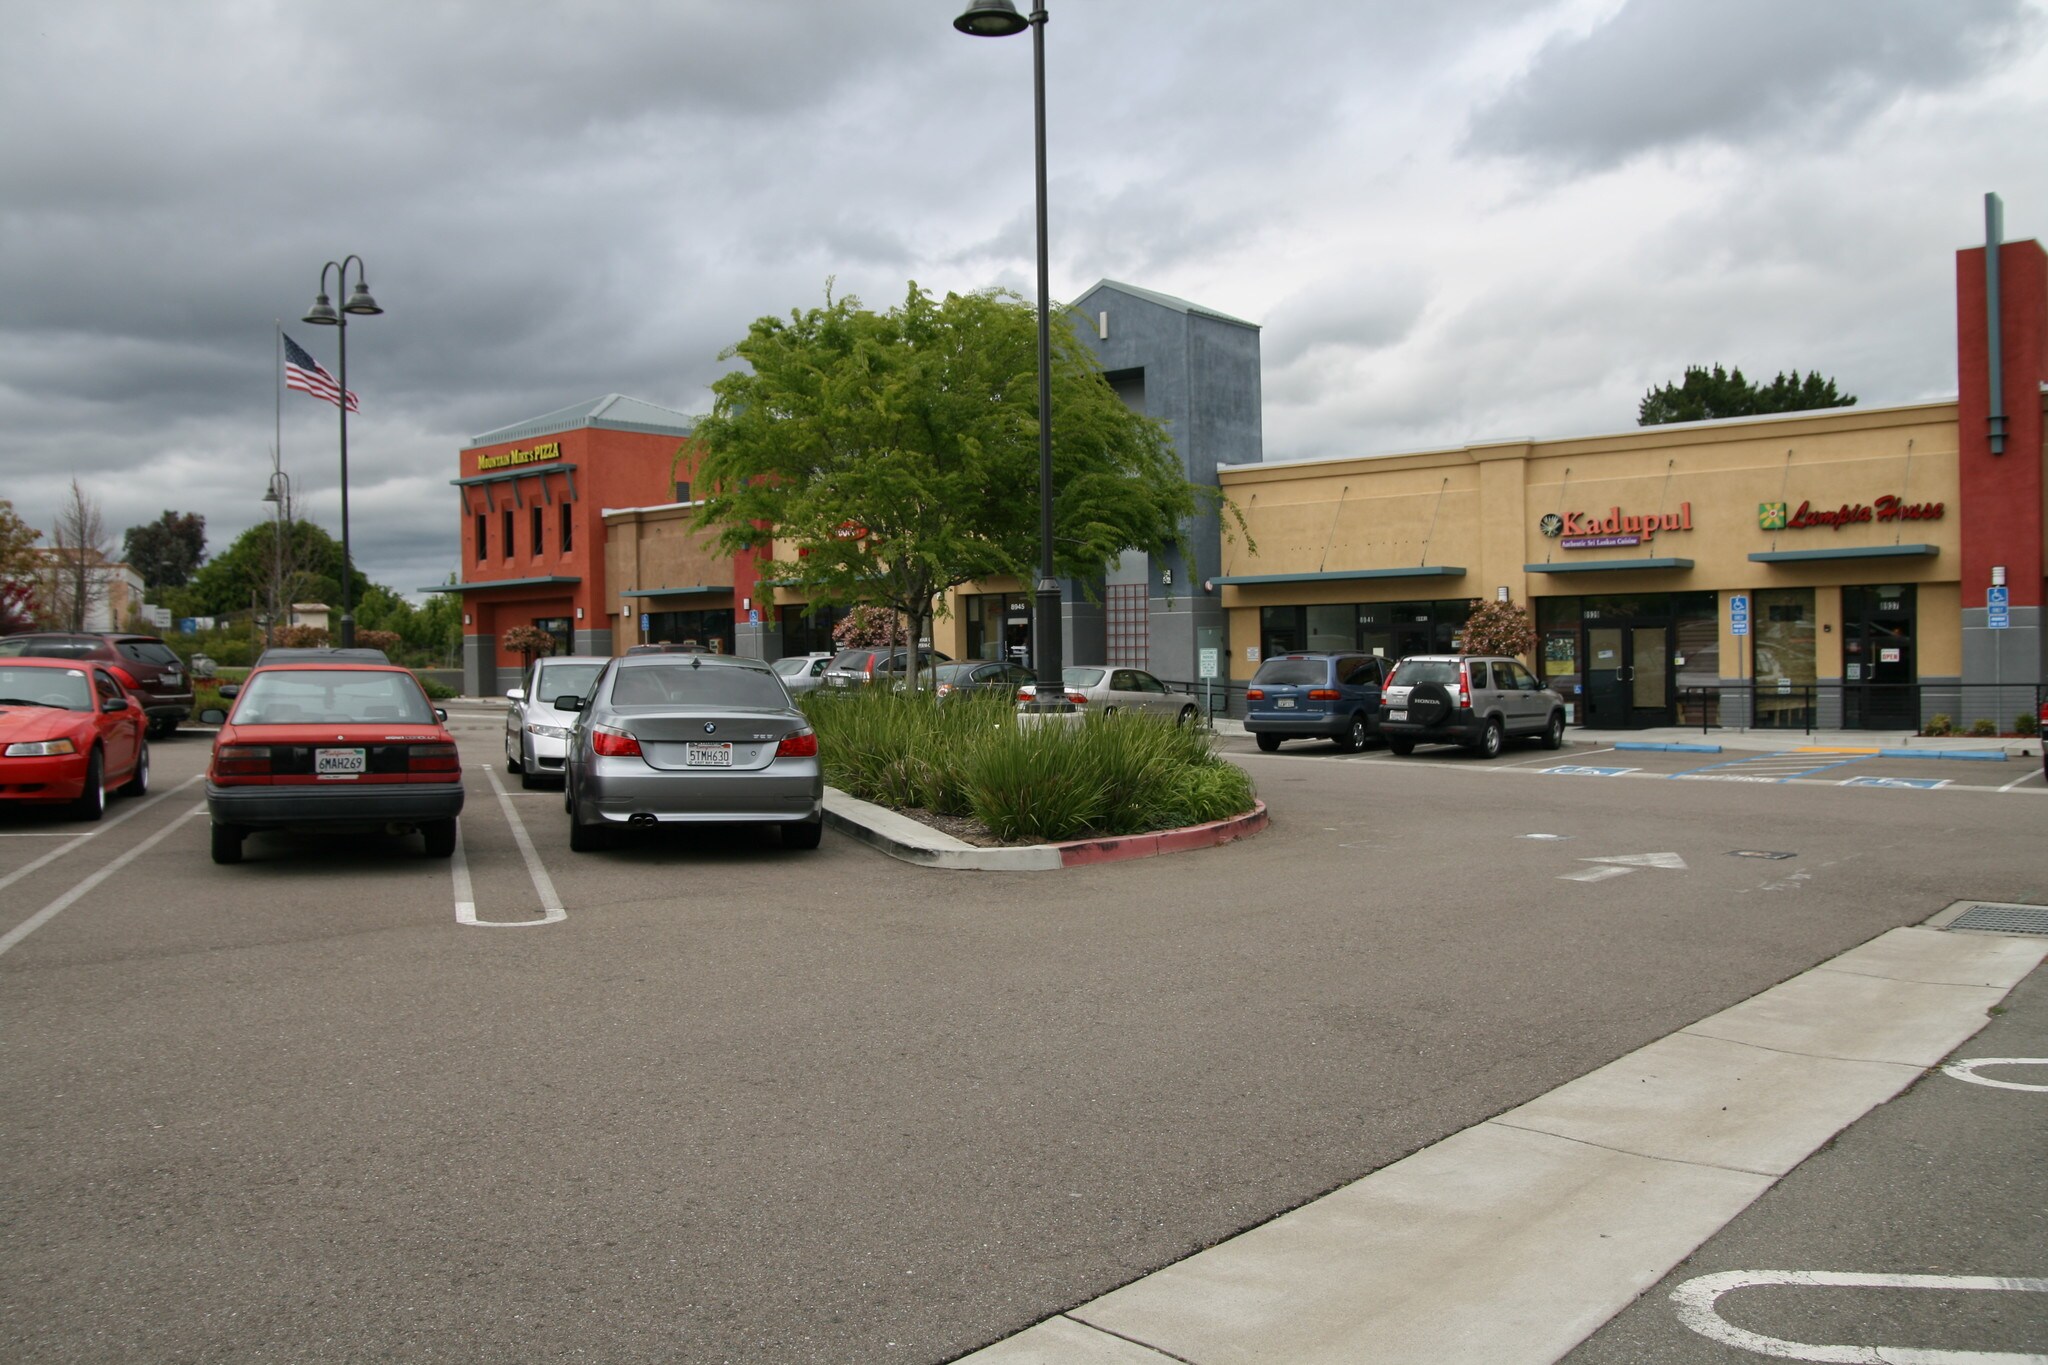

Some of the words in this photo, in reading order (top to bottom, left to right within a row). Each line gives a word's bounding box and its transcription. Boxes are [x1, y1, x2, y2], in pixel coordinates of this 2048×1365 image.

[478, 455, 511, 470] MOUNTAIN
[535, 442, 560, 461] PIZZA
[1562, 502, 1693, 542] Kadupul
[1787, 500, 1872, 531] Lumpia
[1874, 495, 1945, 523] House
[1562, 540, 1586, 548] Authentic
[1596, 538, 1616, 546] Lankan
[1617, 537, 1637, 545] Cuisine
[319, 757, 362, 769] 6MAH269
[690, 750, 729, 761] 5TMH630
